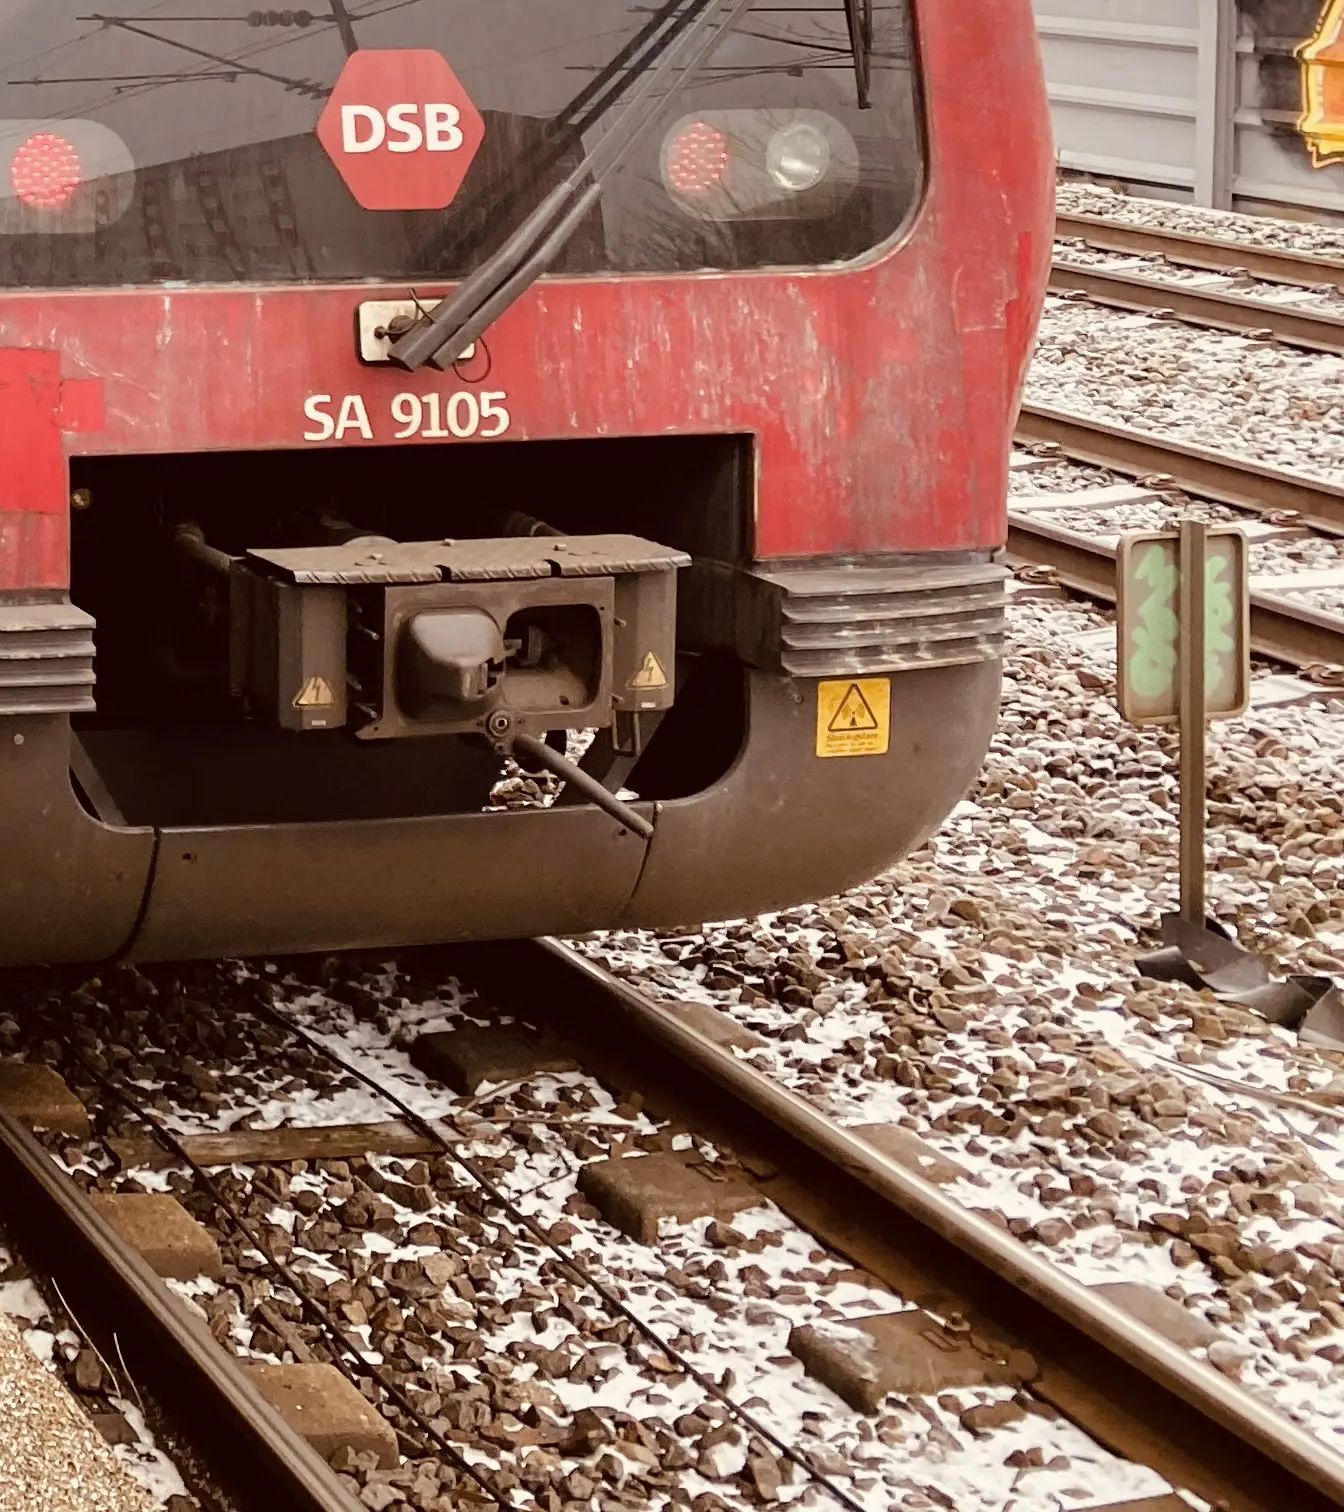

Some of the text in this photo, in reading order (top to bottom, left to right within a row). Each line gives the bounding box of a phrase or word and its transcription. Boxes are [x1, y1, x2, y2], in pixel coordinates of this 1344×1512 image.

[341, 103, 464, 153] DSB
[303, 391, 510, 441] SA 9105
